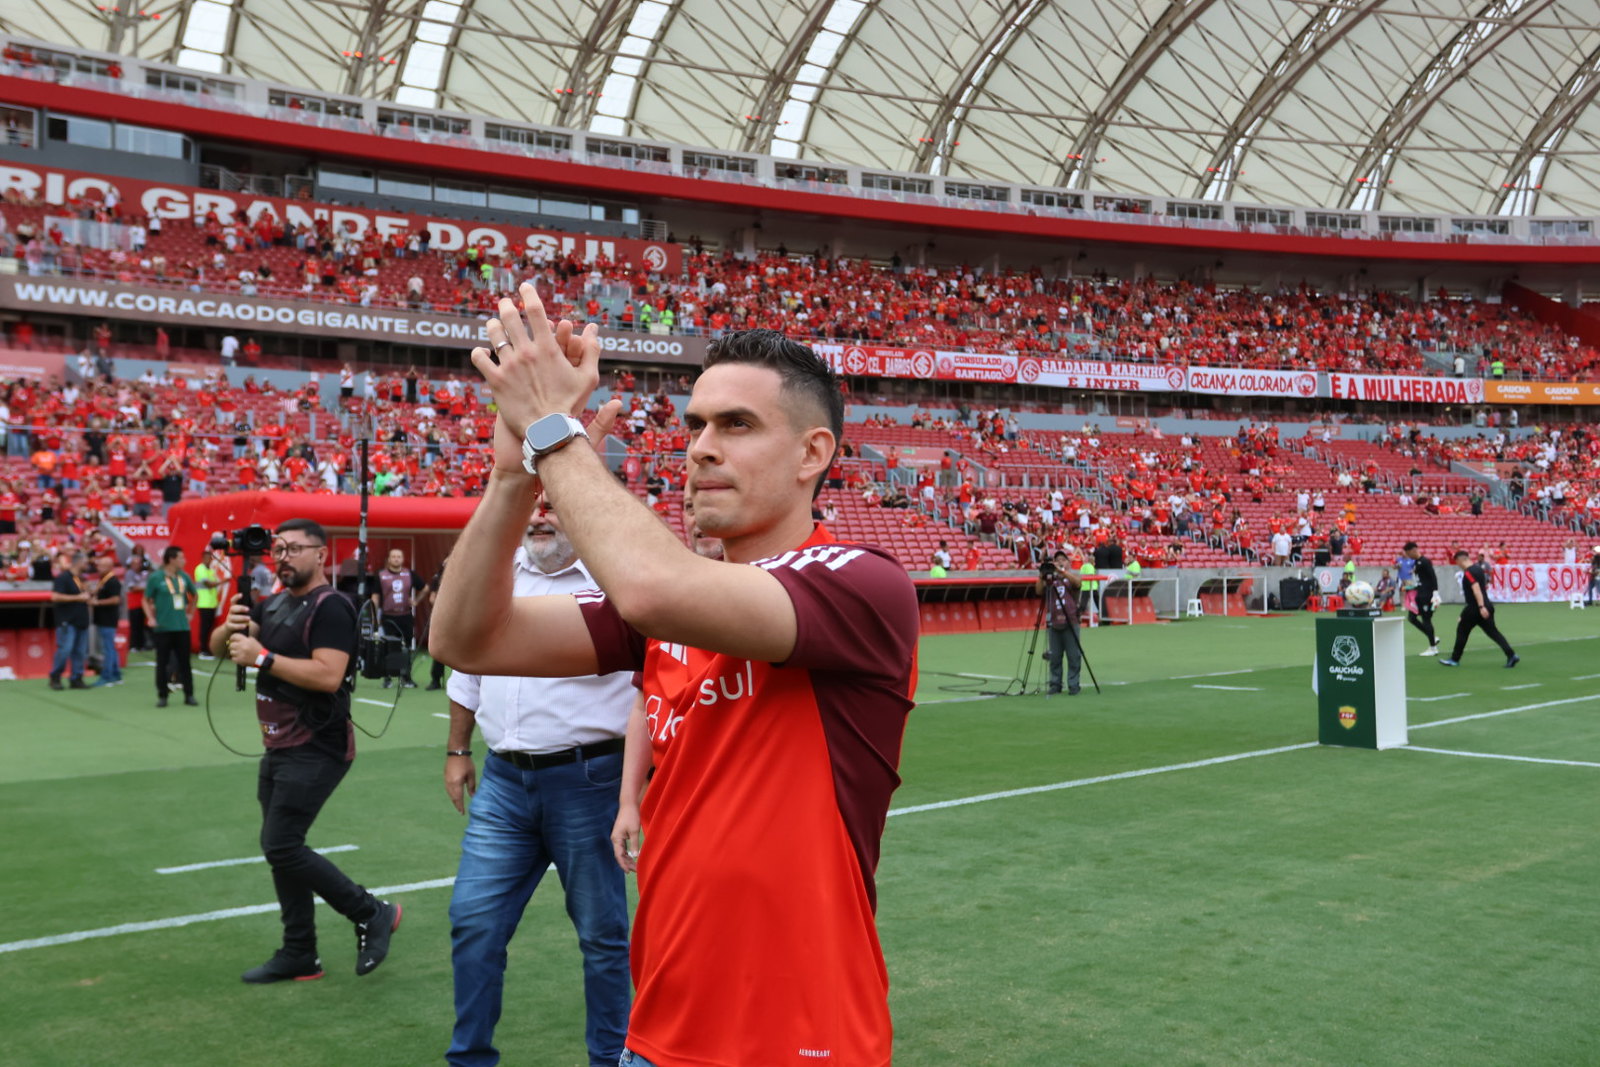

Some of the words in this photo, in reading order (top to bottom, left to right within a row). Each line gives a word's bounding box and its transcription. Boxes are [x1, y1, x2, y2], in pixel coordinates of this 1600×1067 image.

[954, 355, 1002, 366] CONSULADO
[1041, 360, 1107, 376] SALDANHA
[1111, 362, 1166, 379] MARINHO
[1068, 377, 1079, 388] E
[1086, 378, 1140, 390] INTER
[1190, 372, 1237, 393] CRIANÇA
[1239, 375, 1294, 393] COLORADA
[1347, 377, 1360, 401] A
[1363, 378, 1469, 403] MULHERADA
[1329, 665, 1364, 675] GAUCHÃO
